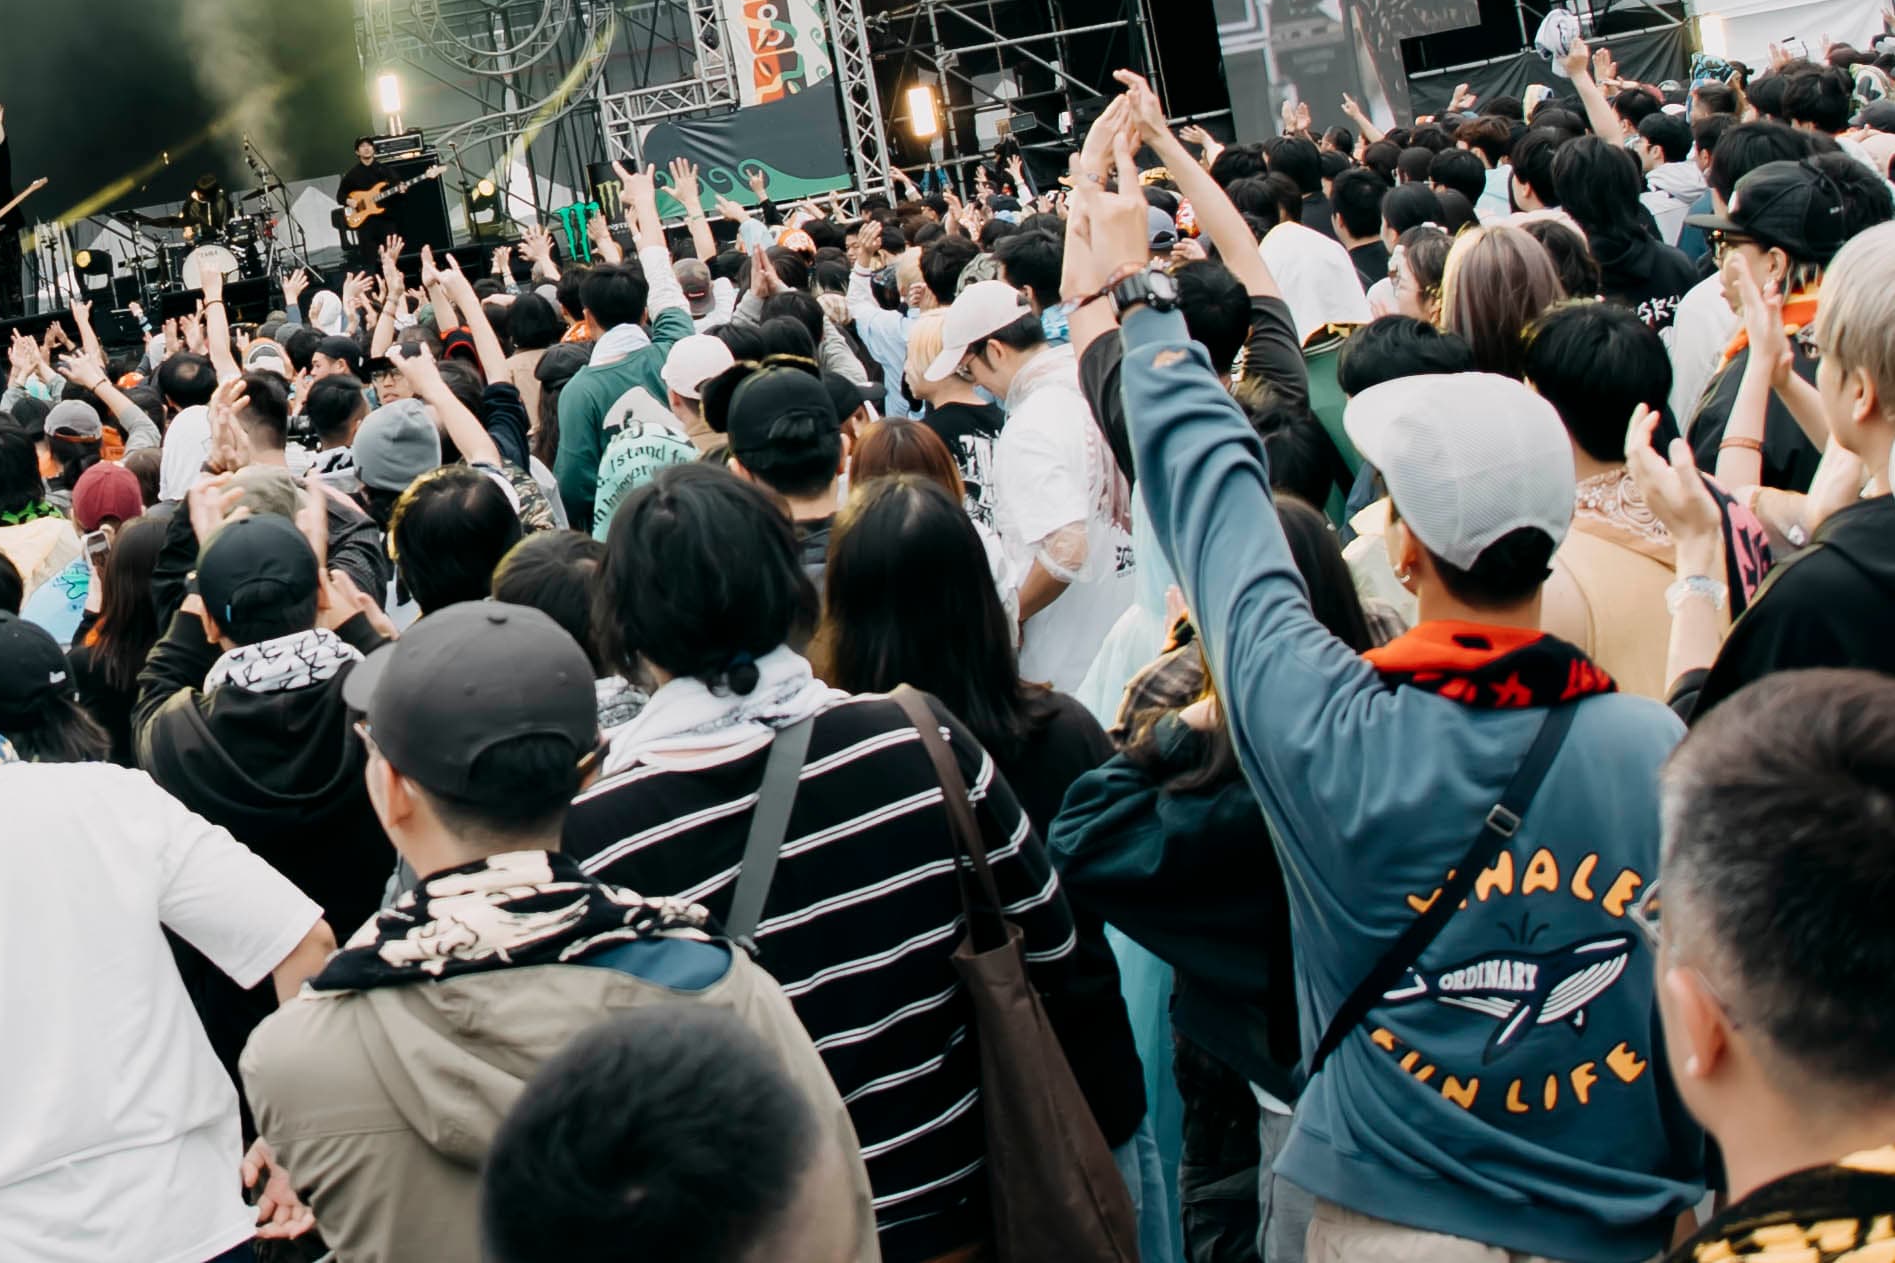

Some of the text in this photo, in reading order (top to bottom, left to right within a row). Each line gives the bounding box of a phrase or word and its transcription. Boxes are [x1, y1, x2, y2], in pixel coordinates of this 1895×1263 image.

[617, 444, 666, 468] stand
[1438, 959, 1538, 991] ORDINARY
[1505, 1041, 1647, 1113] LIFE
